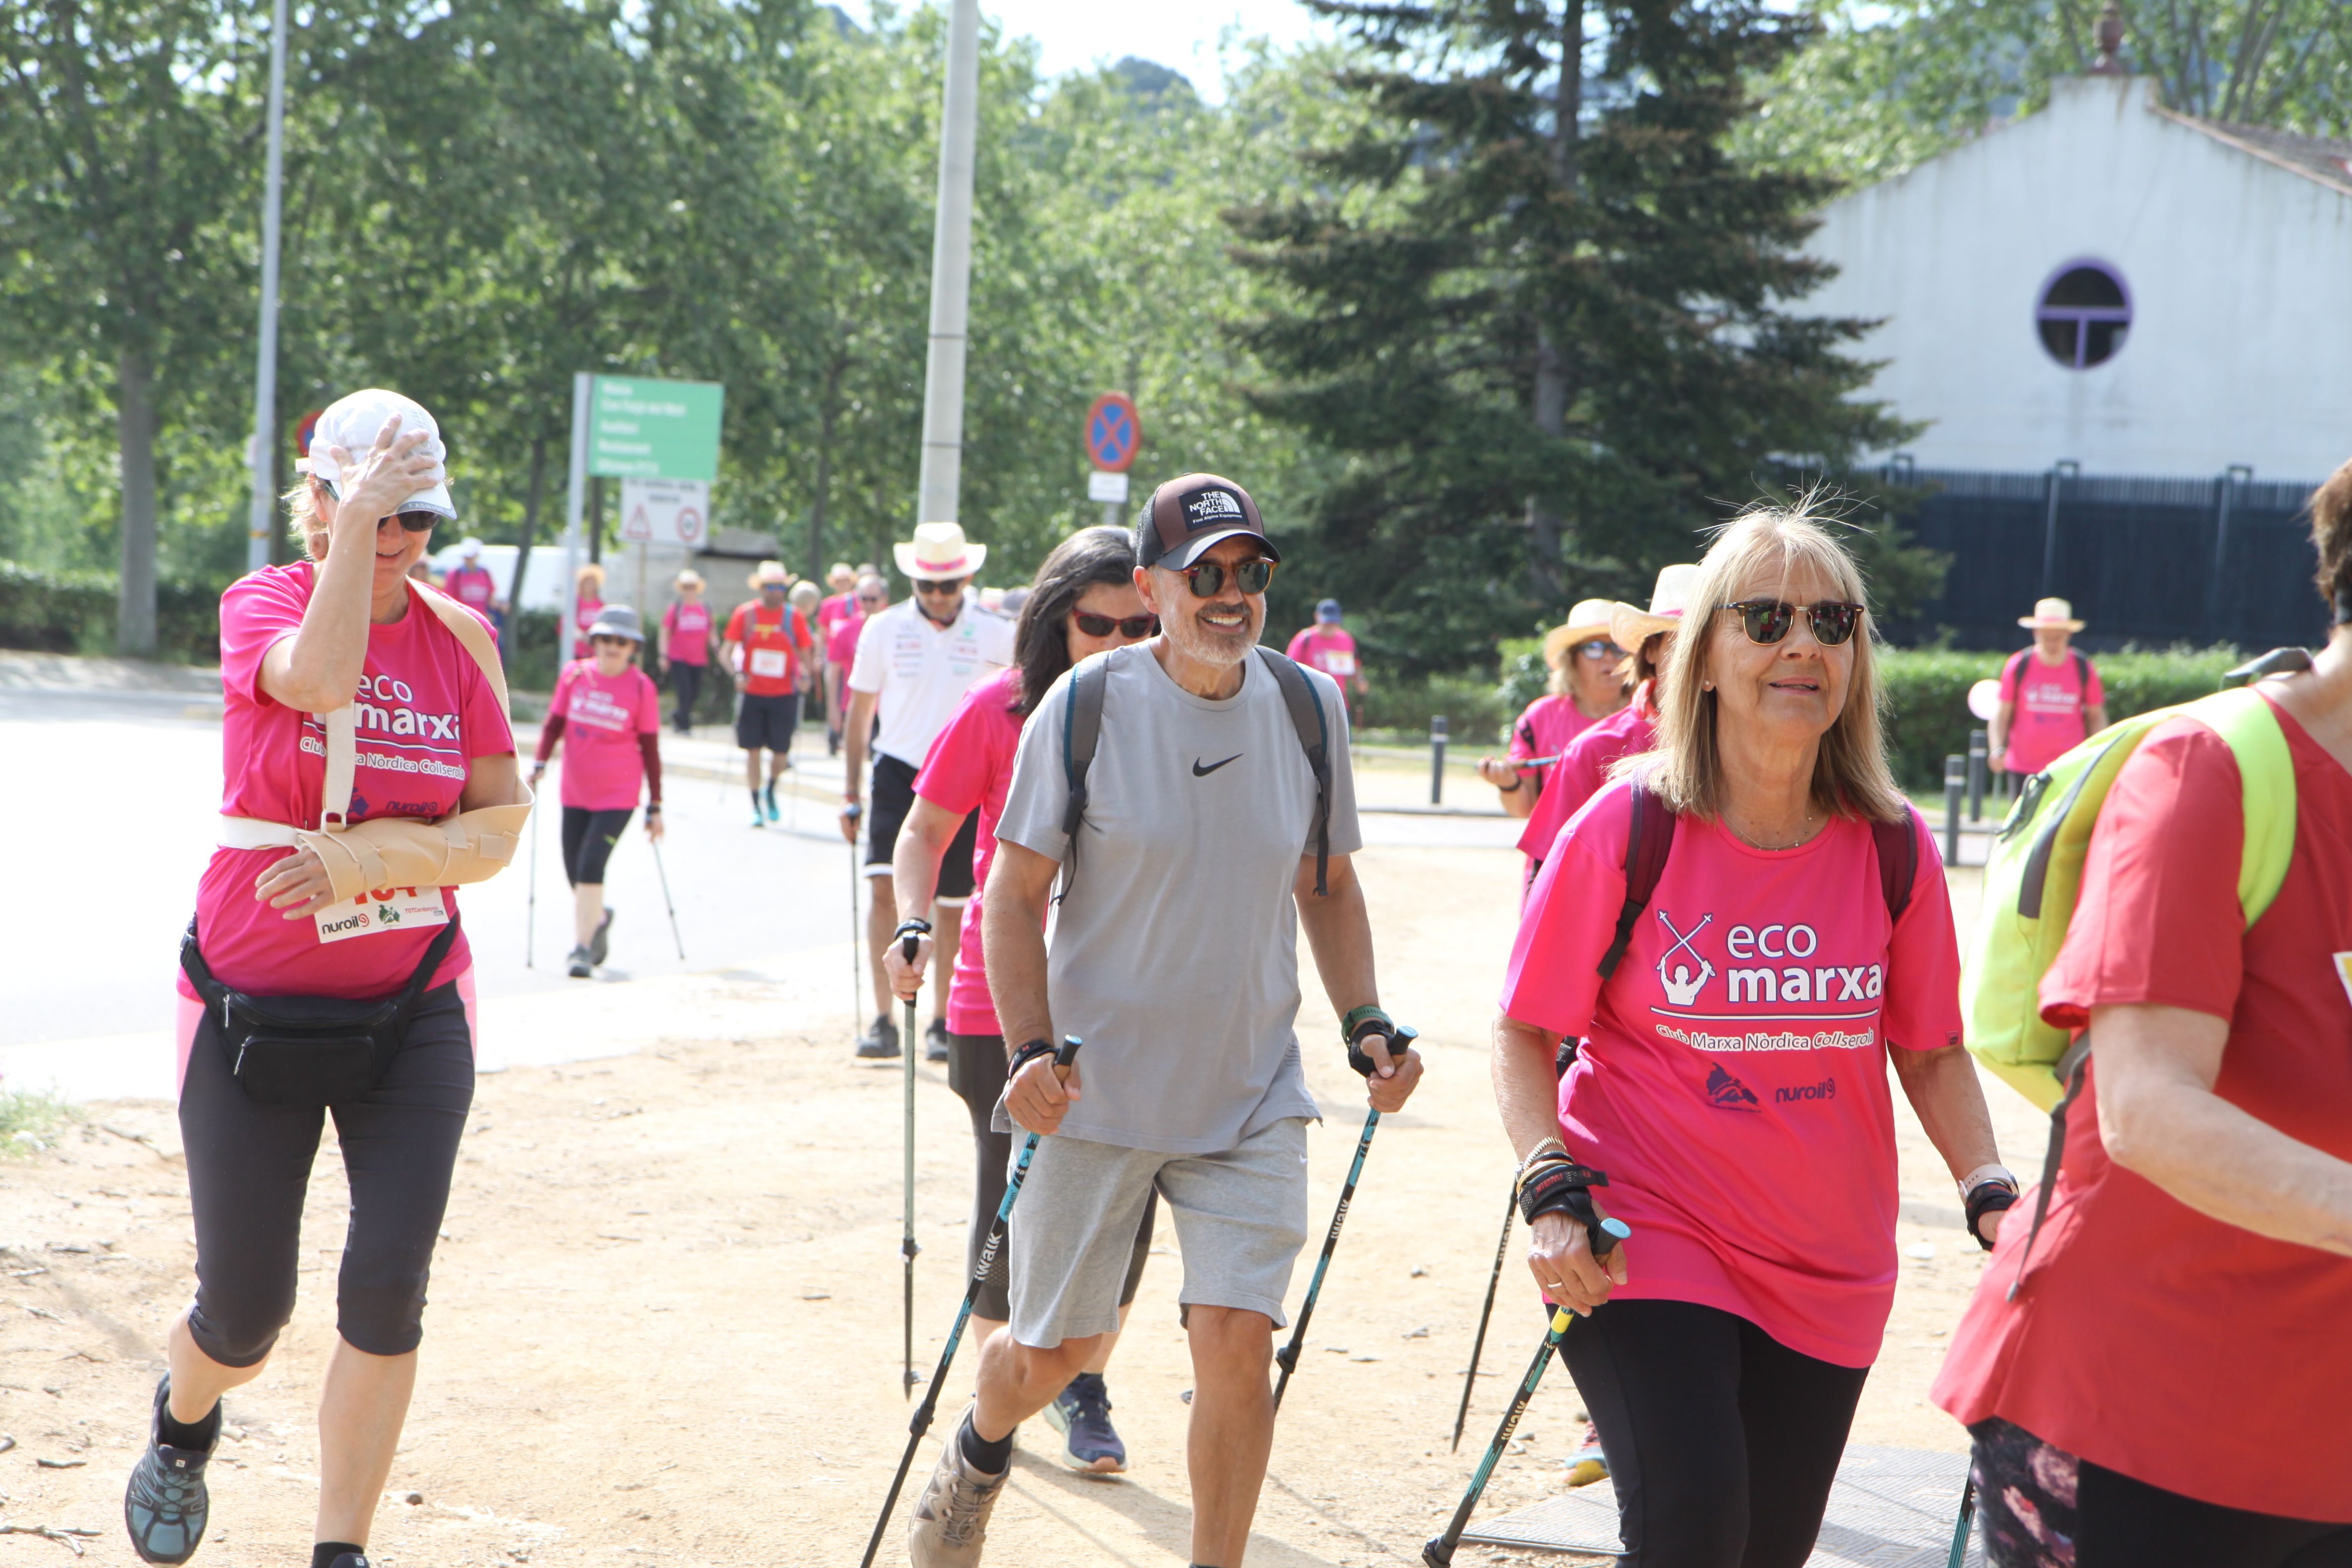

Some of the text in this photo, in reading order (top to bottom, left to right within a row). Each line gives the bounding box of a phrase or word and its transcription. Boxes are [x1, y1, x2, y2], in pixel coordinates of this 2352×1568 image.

[1189, 498, 1223, 512] NORTH
[1201, 491, 1221, 500] THE
[1200, 505, 1225, 516] FACE
[357, 674, 413, 702] eco
[368, 753, 417, 772] Nòrdica
[420, 759, 465, 779] Collserola
[385, 800, 429, 812] nuroil
[322, 916, 359, 934] nuroil
[1727, 925, 1817, 958] eco
[1728, 963, 1882, 1002] marxa
[1657, 1025, 1873, 1050] Club Marxa Nòrdica Collserola
[1775, 1081, 1827, 1103] nuroil
